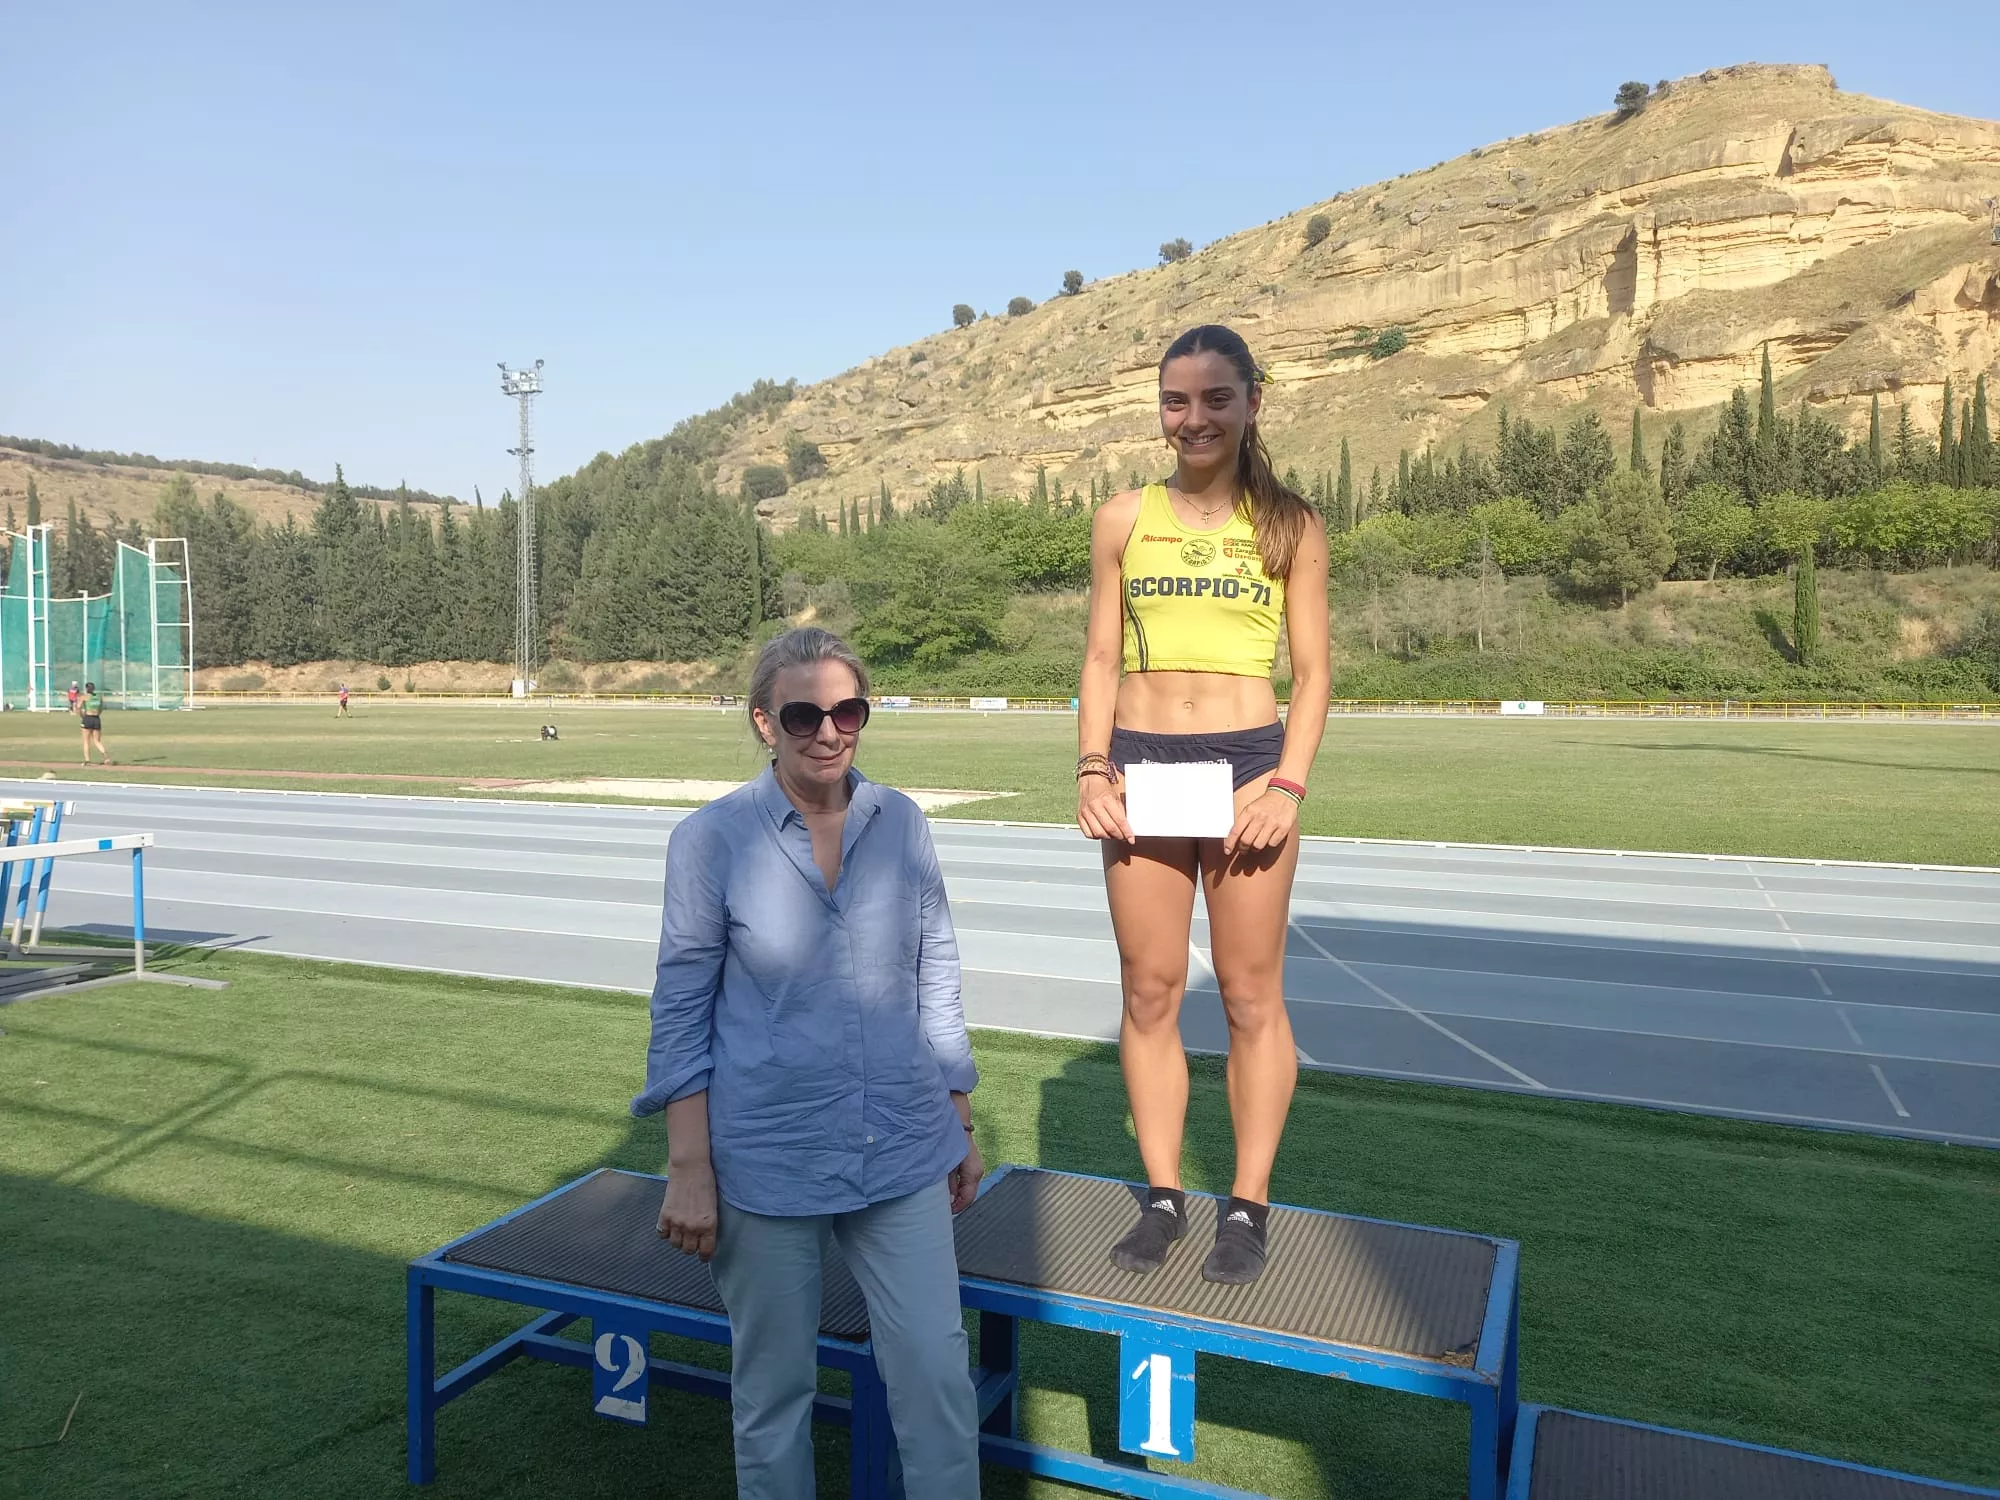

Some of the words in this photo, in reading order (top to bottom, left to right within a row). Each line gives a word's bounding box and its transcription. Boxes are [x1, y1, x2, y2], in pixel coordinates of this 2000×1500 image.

[1141, 534, 1183, 544] Alcampo
[1129, 576, 1271, 607] SCORPIO-71
[1151, 1201, 1178, 1218] adidas
[1226, 1213, 1254, 1228] adidas
[594, 1332, 646, 1422] 2
[1131, 1353, 1180, 1456] 1
